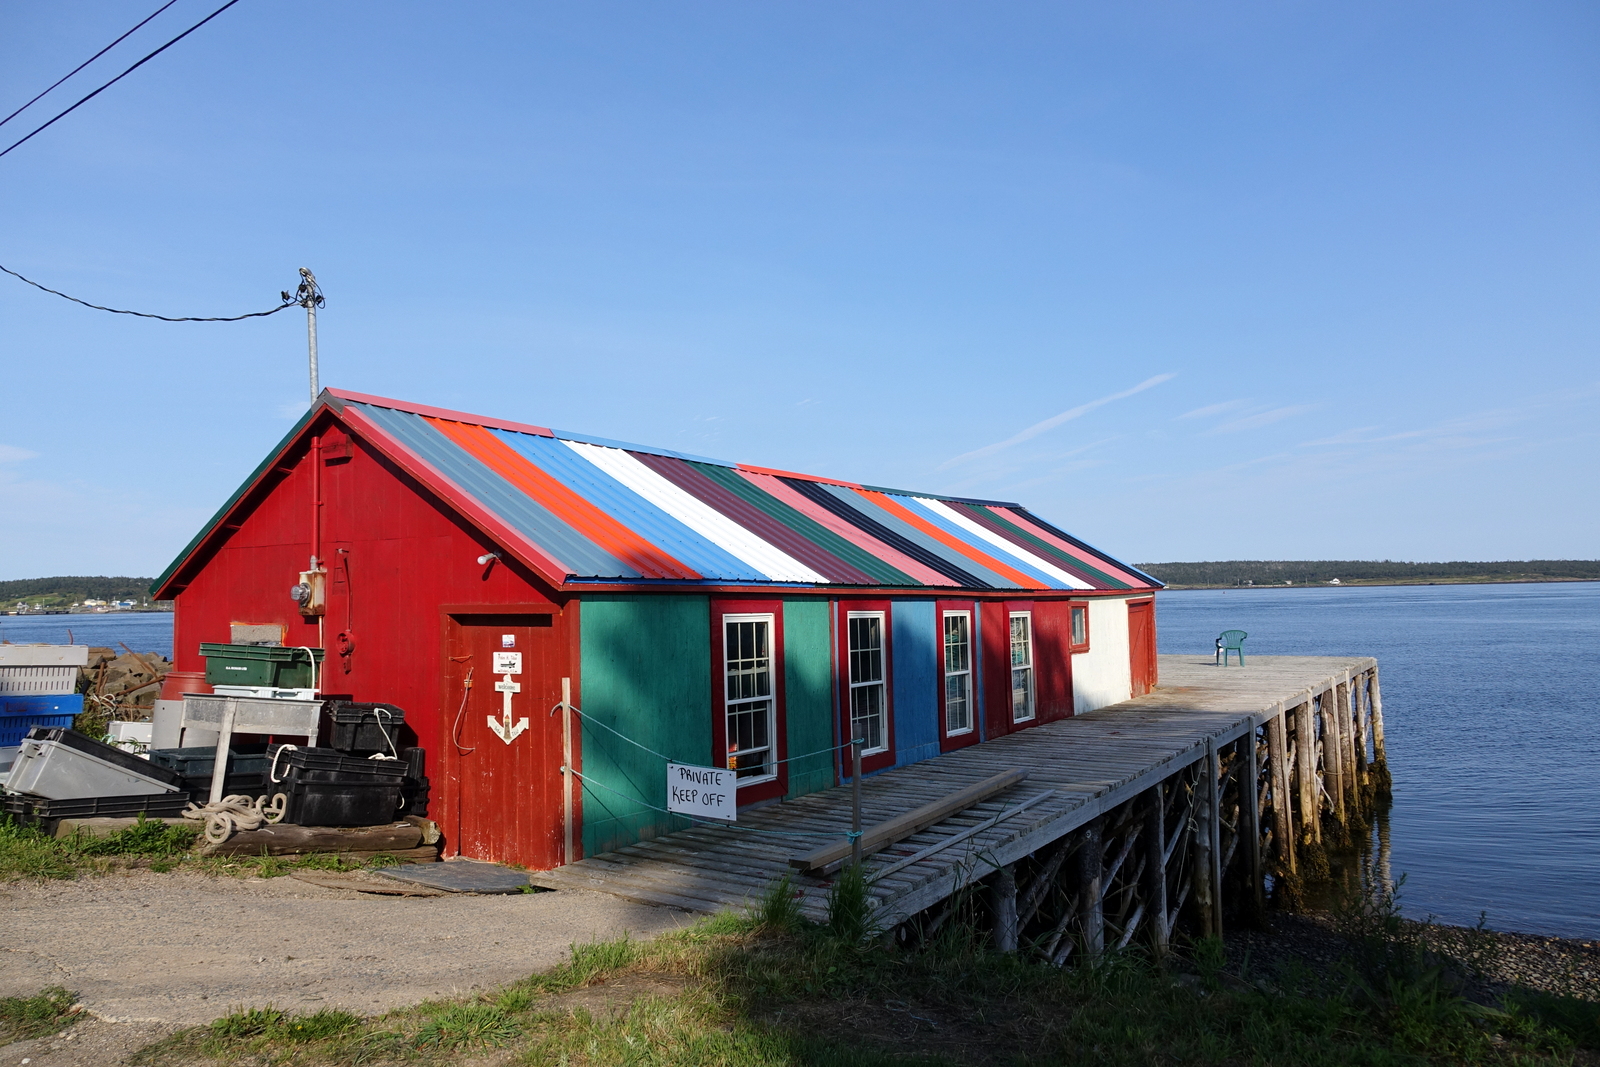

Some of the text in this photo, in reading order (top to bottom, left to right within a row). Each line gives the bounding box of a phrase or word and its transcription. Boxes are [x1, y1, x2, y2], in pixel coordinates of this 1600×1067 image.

[677, 767, 723, 786] PRIVATE
[672, 785, 726, 807] KEEP OFF
